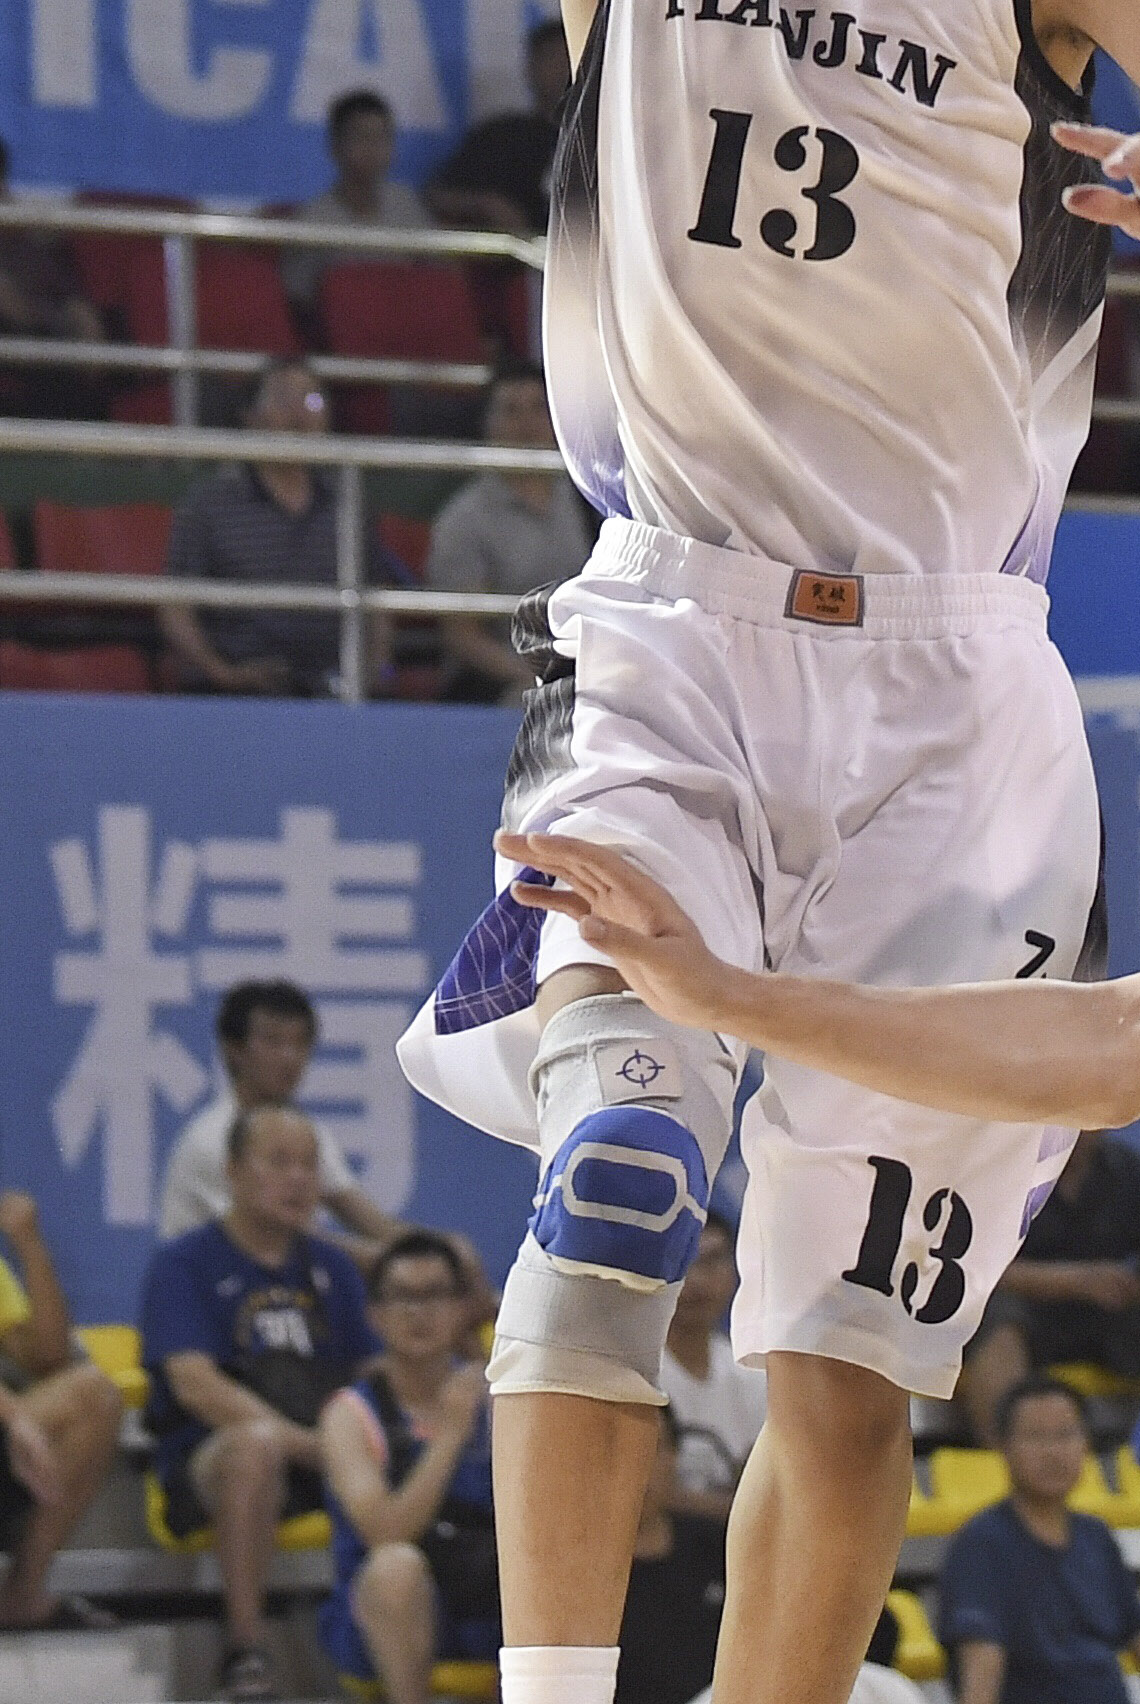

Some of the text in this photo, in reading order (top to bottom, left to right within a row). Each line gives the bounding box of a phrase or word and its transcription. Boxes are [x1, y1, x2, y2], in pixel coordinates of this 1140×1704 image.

[687, 108, 860, 262] 13
[51, 804, 430, 1229] 精
[841, 1154, 973, 1325] 13
